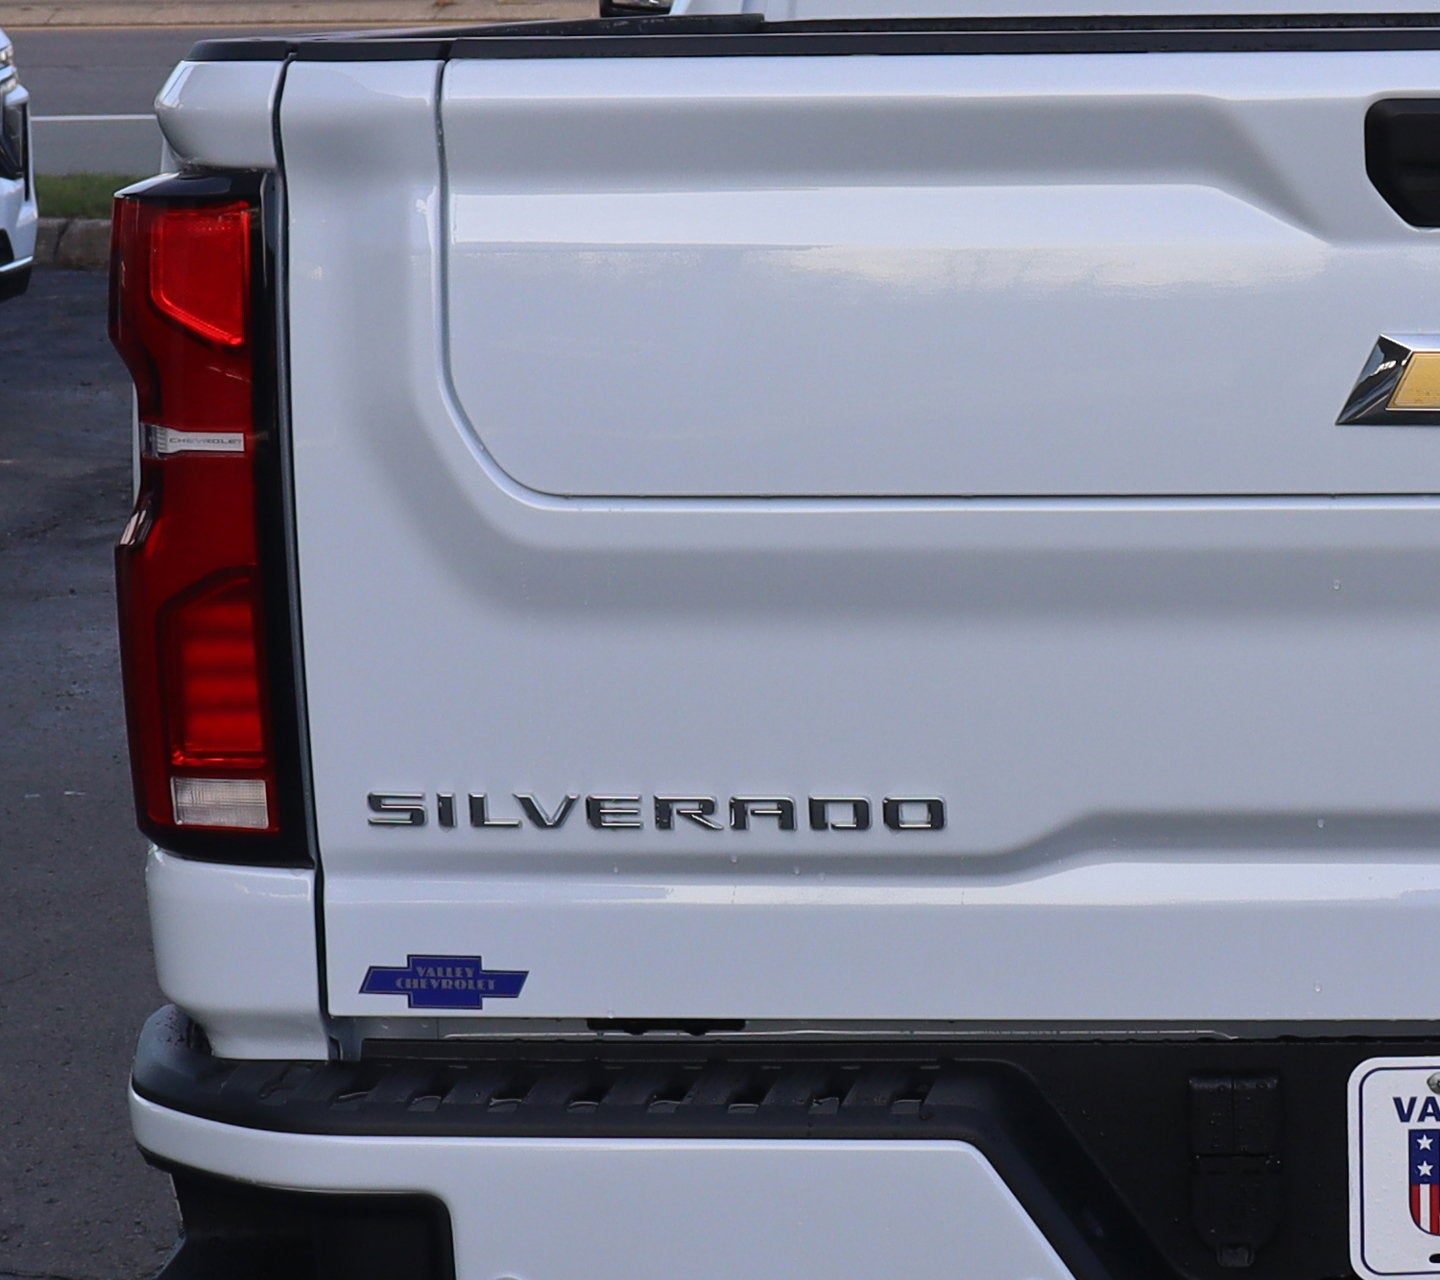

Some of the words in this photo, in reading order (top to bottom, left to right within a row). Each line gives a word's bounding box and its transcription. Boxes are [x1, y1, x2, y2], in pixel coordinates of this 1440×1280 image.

[367, 793, 947, 832] SILVERADO
[415, 966, 475, 978] VALLEY
[396, 978, 496, 991] CHEVROLET
